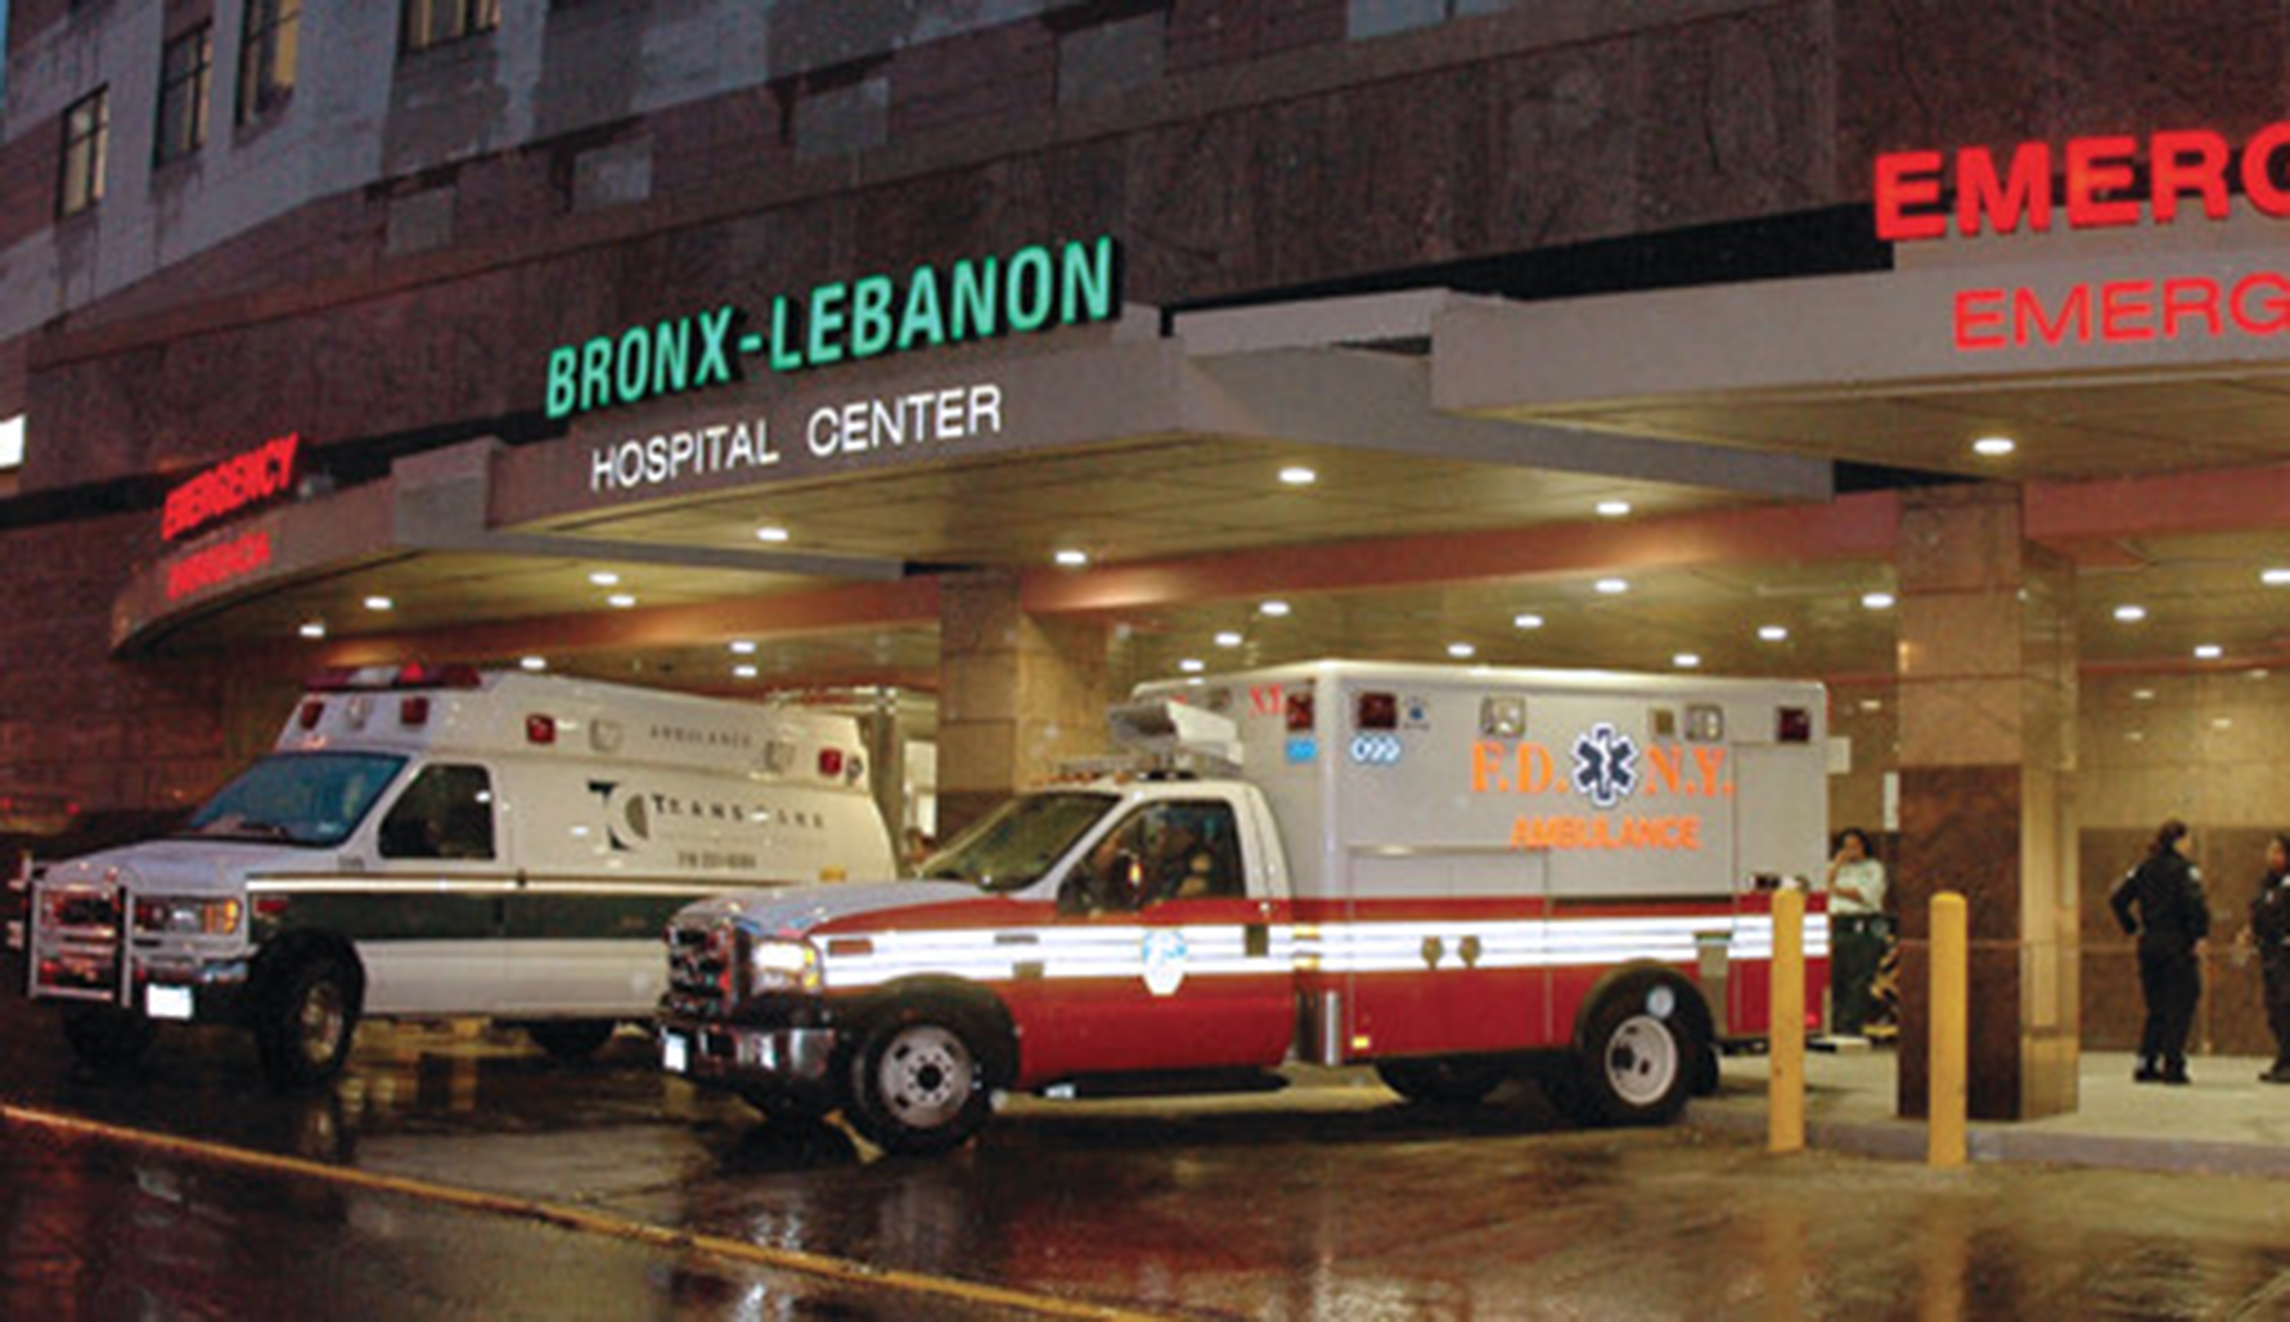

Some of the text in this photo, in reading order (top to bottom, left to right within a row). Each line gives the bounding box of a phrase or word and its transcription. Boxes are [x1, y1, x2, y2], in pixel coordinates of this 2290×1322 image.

[546, 236, 1111, 418] BRONX-LEBANON
[1954, 272, 2290, 350] EMERG
[592, 384, 1001, 490] HOSPITAL CENTER
[161, 431, 299, 541] EMERGENCY
[1471, 740, 1736, 798] F.D. N.Y.
[1510, 815, 1701, 850] AMBULANCE
